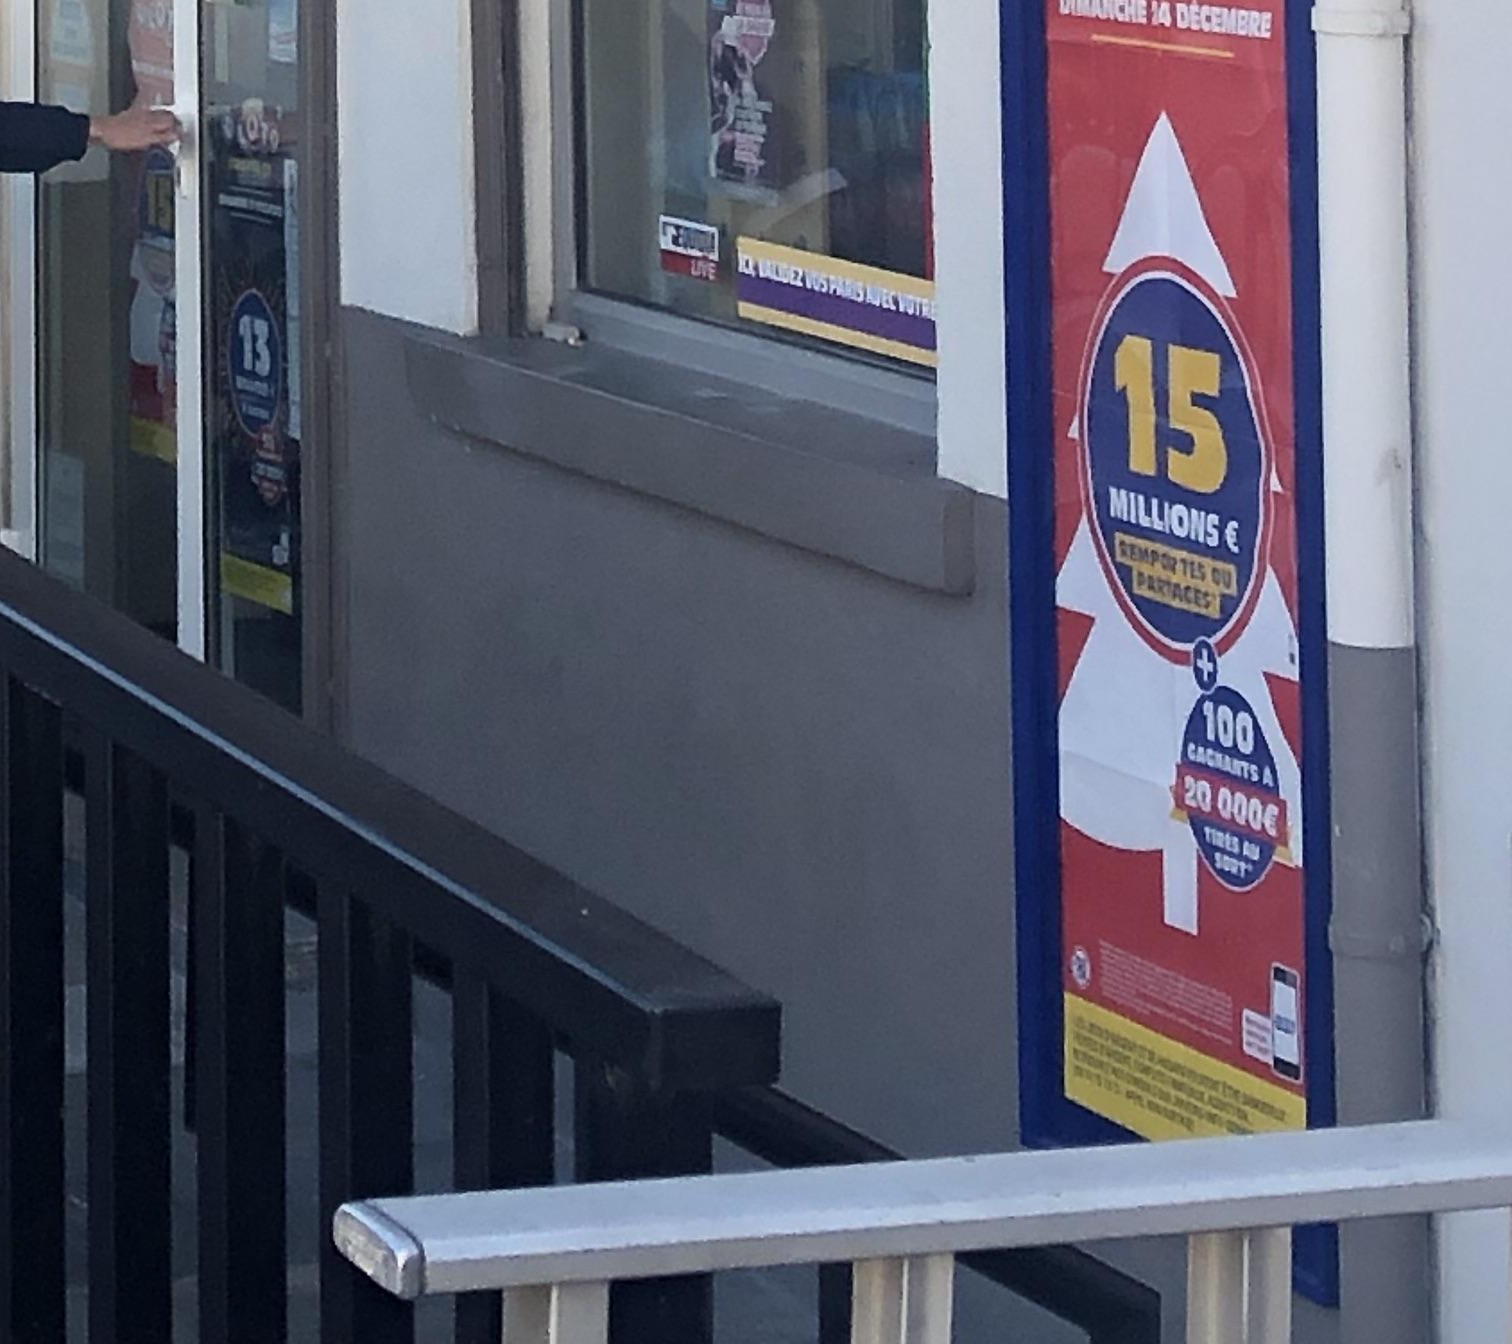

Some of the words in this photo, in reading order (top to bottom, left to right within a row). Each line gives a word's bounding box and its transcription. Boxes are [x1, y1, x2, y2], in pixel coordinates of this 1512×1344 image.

[1150, 0, 1173, 28] 14
[1175, 0, 1273, 40] DÉCEMBRE
[239, 314, 271, 377] 13
[1114, 334, 1229, 494] 15
[1108, 485, 1220, 547] MILLIONS
[1224, 520, 1240, 554] €
[1202, 699, 1255, 755] 100
[1187, 741, 1260, 783] GAGNANTS
[1184, 774, 1213, 814] 20
[1217, 786, 1280, 838] 000€
